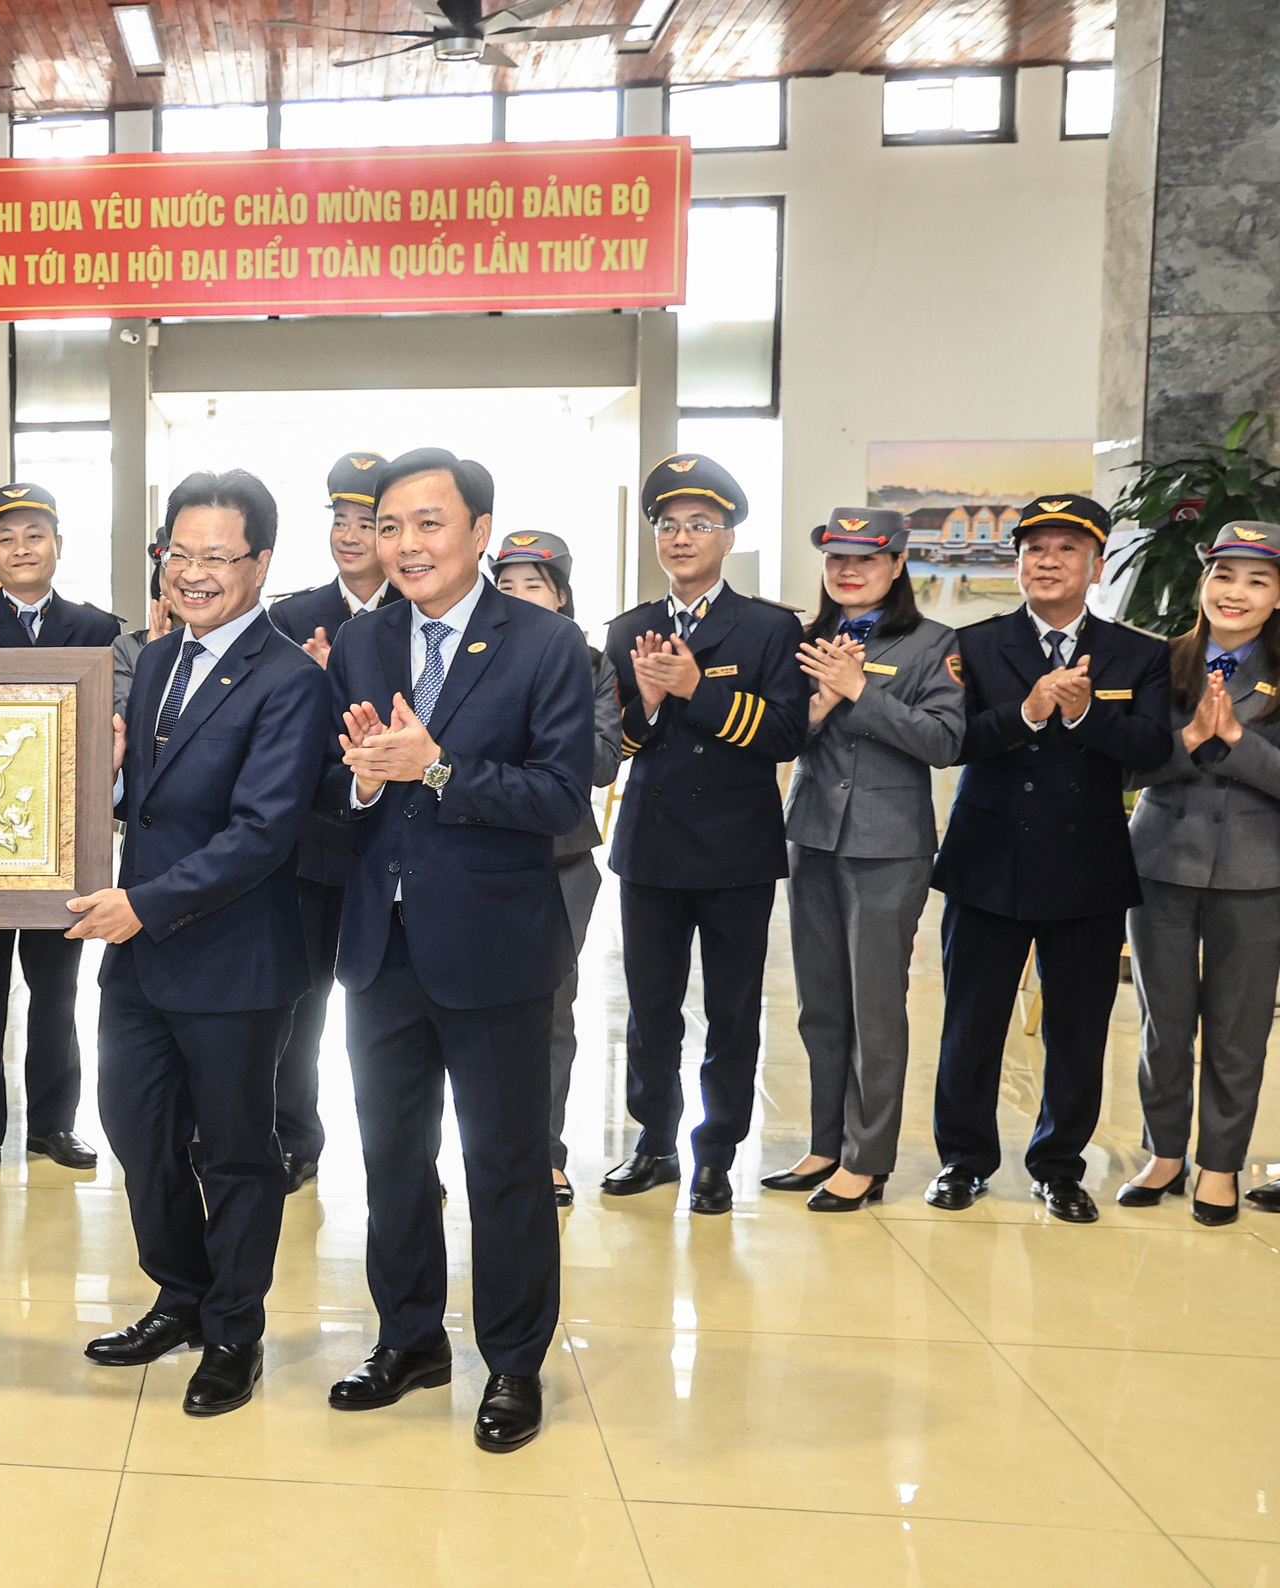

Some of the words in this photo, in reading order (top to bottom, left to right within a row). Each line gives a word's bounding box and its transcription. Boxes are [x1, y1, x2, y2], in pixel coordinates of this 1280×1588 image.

[29, 200, 83, 232] ĐUA
[91, 192, 142, 230] YÊU
[150, 189, 226, 228] NƯỚC
[234, 186, 308, 226] CHÀO
[317, 185, 402, 223] MỪNG
[410, 188, 458, 228] ĐẠI
[467, 180, 514, 226] HỘI
[523, 174, 603, 218] ĐẢNG
[611, 175, 651, 222] BỘ
[24, 247, 66, 285] TỚI
[73, 252, 119, 290] ĐẠI
[128, 244, 173, 289] HỘI
[181, 249, 227, 287] ĐẠI
[236, 235, 299, 280] BIỂU
[307, 239, 381, 279] TOÀN
[389, 232, 465, 280] QUỐC
[474, 231, 529, 275] LẦN
[537, 233, 596, 273] THỨ
[600, 238, 649, 272] XIV
